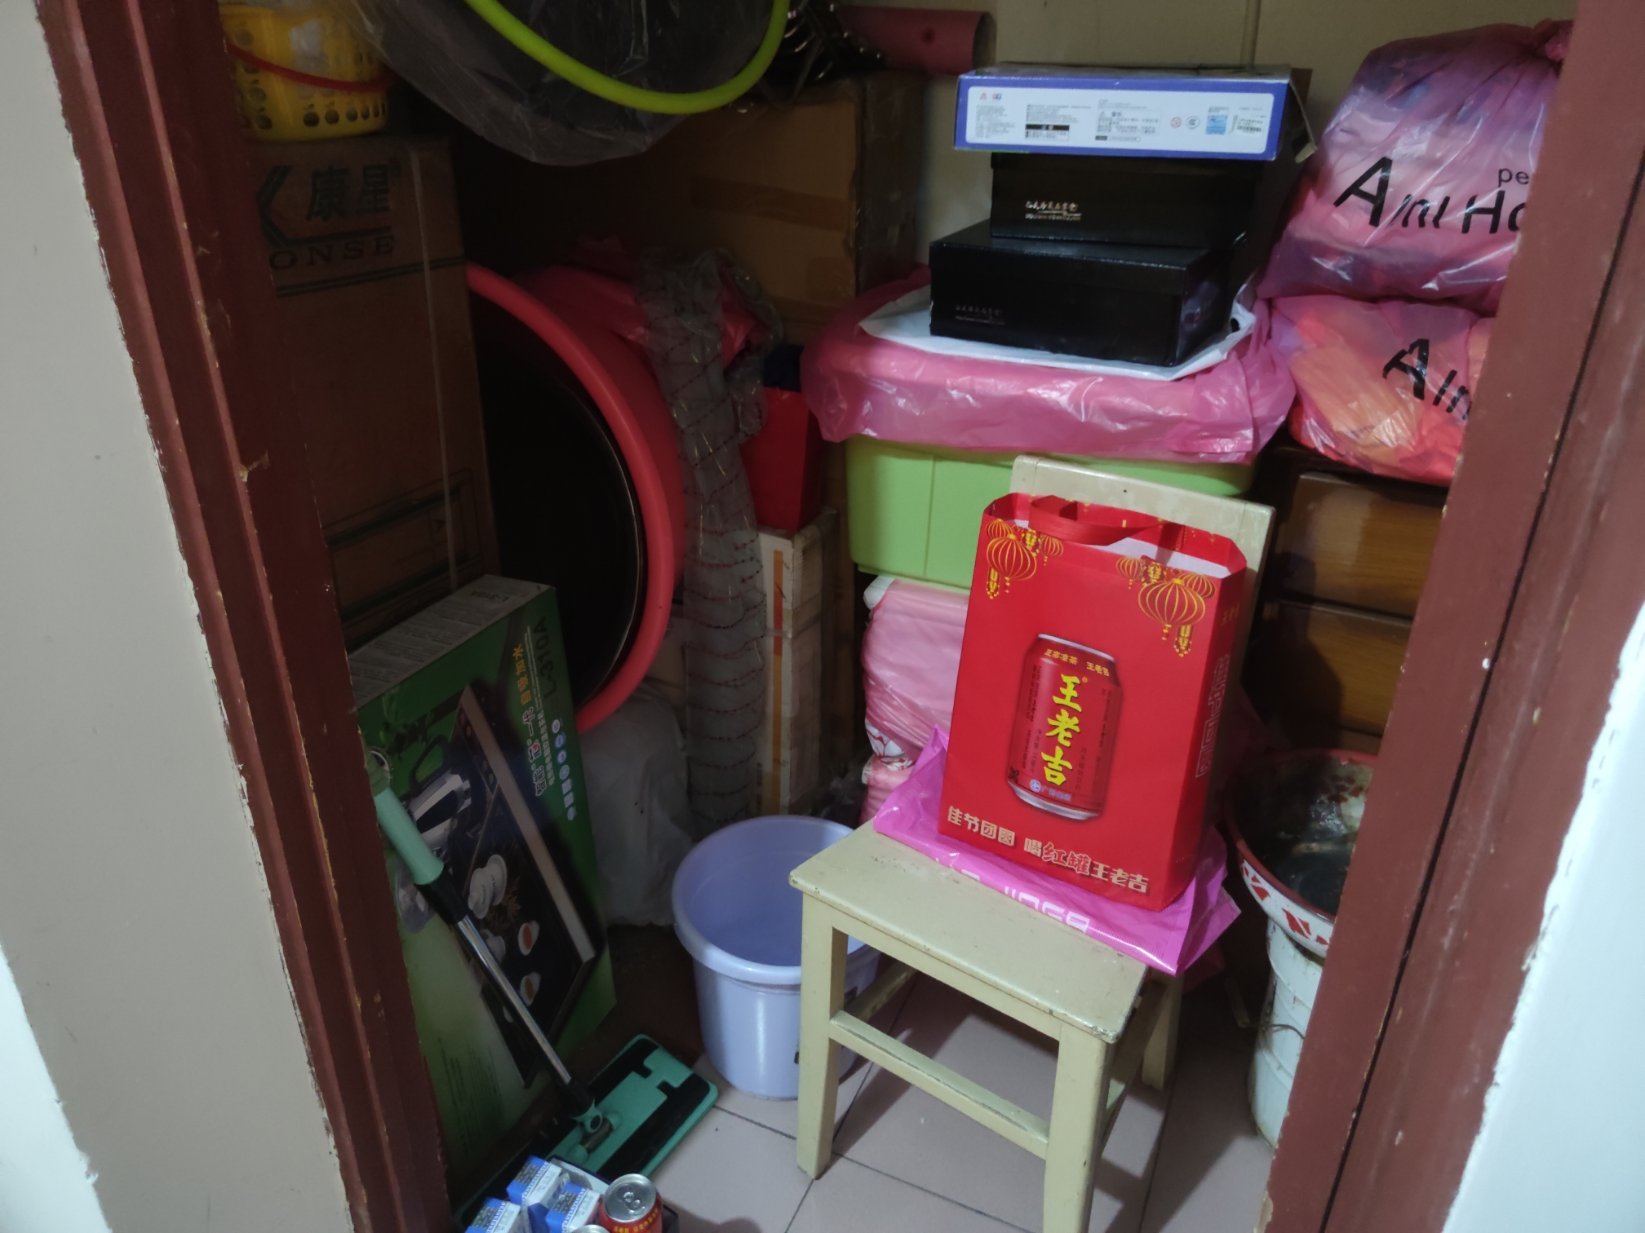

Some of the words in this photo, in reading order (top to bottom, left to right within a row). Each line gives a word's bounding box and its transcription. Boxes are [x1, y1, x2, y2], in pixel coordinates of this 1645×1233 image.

[1041, 673, 1083, 787] 王老吉
[947, 805, 1016, 847] 佳节团圆
[1023, 837, 1150, 894] 喝红罐王老吉
